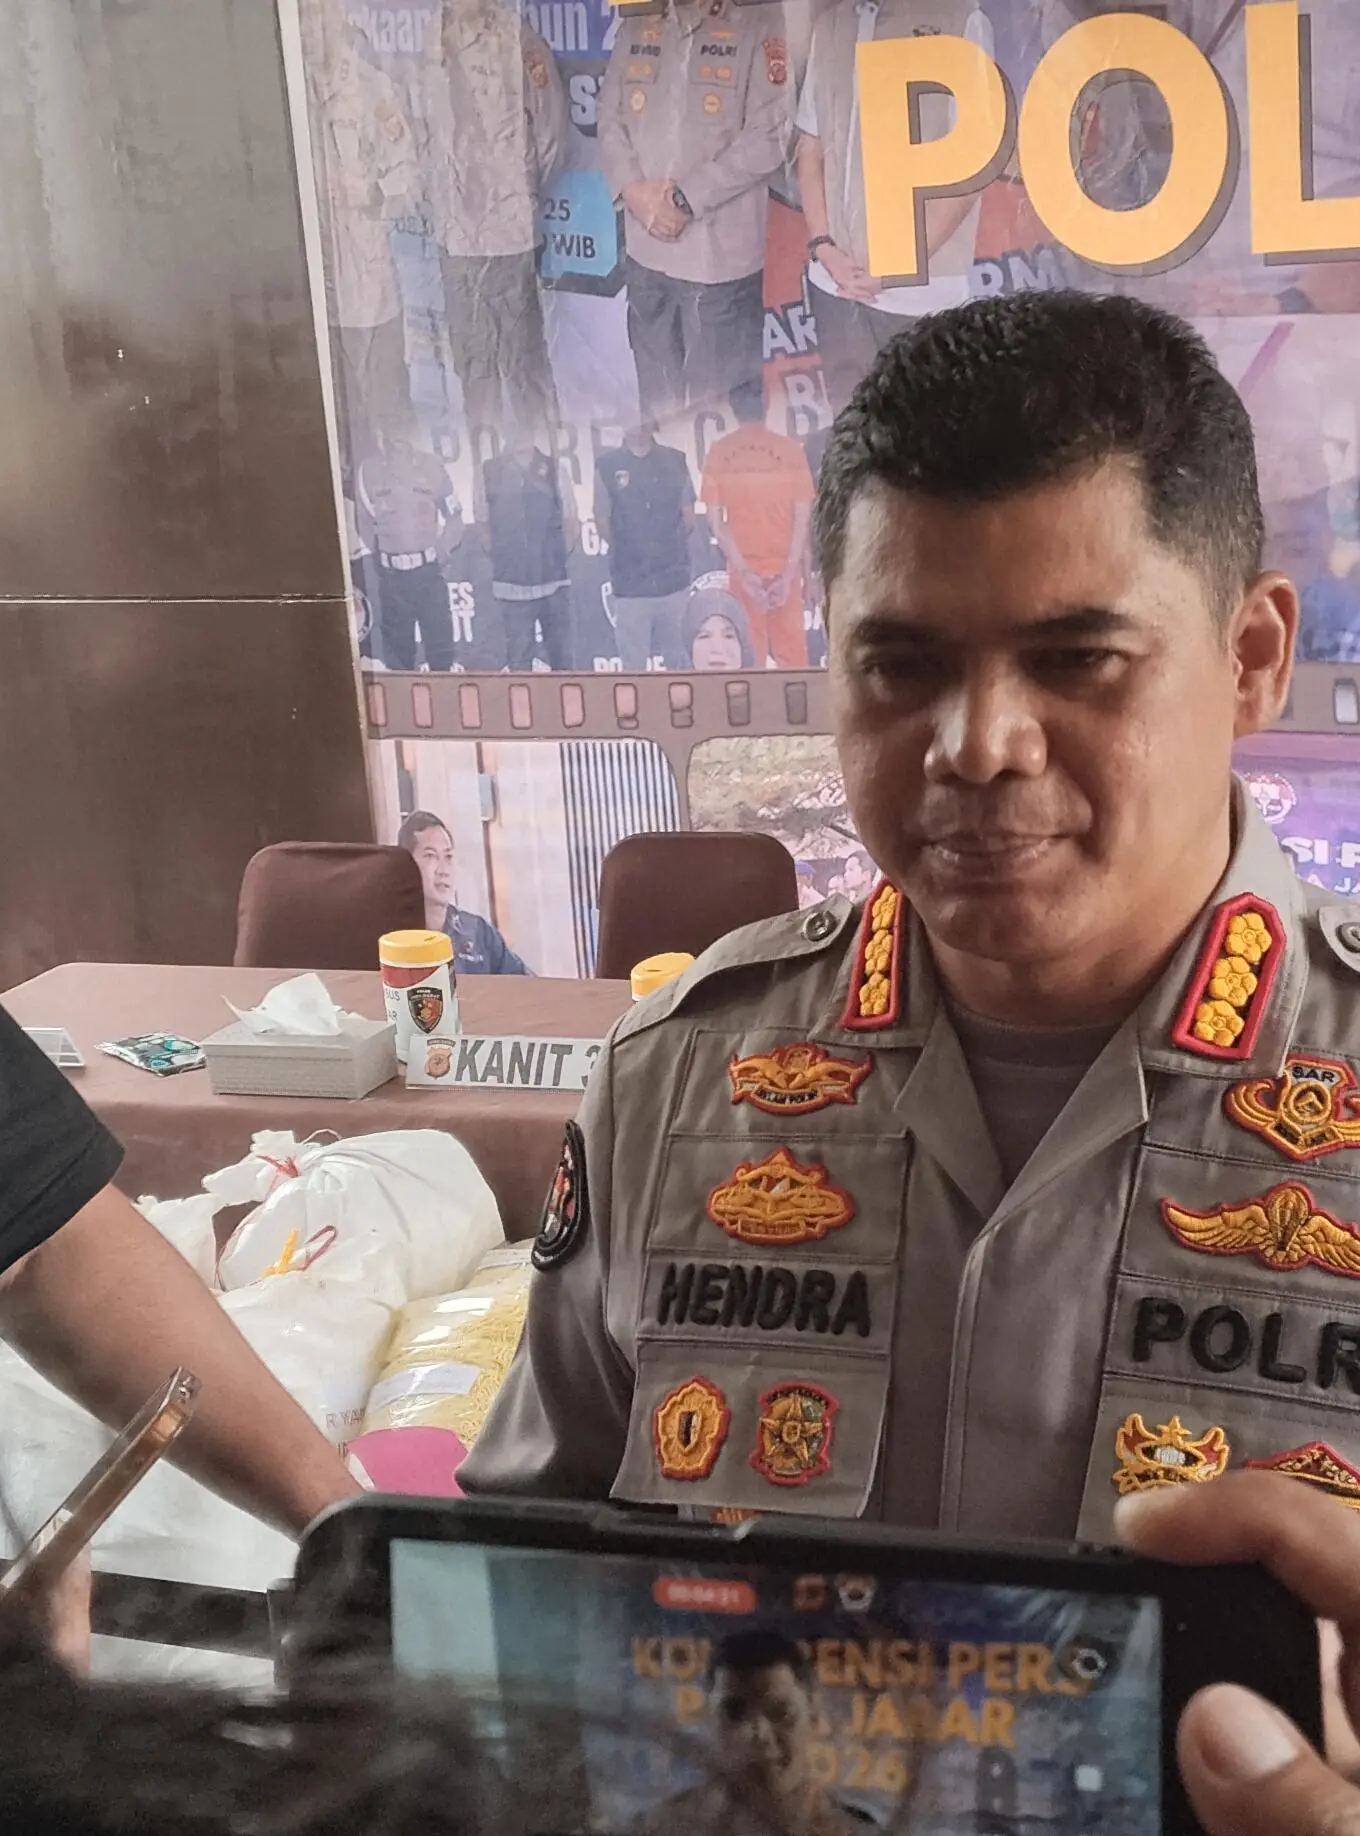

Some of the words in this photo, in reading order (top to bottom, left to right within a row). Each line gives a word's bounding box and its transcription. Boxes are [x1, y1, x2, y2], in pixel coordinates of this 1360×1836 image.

[455, 1039, 573, 1087] KANIT
[1292, 1066, 1335, 1083] SAR
[657, 1262, 872, 1338] HENDRA
